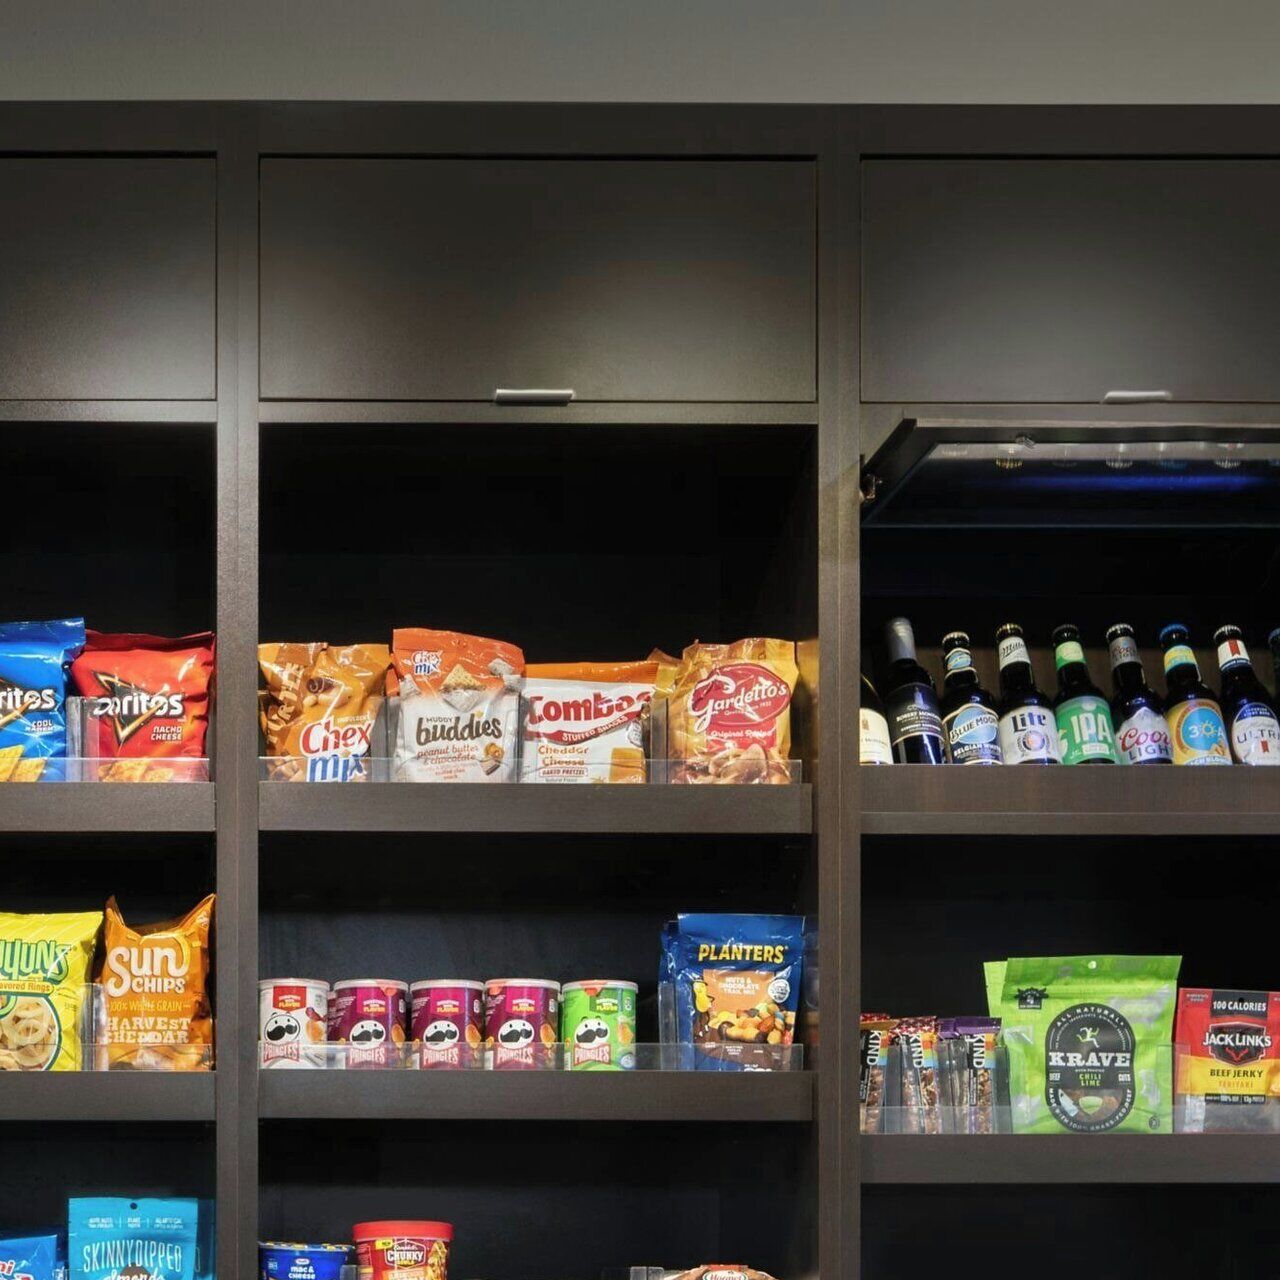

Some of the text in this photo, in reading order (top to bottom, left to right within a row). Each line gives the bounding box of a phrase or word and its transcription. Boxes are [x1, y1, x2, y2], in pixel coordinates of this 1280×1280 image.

[689, 674, 789, 732] Gardetto's
[416, 713, 503, 746] buddies
[1011, 711, 1048, 734] Lite
[1071, 714, 1112, 743] IPA
[300, 716, 372, 755] Chex
[538, 745, 589, 756] Cheddar
[307, 753, 367, 782] mix
[698, 944, 784, 964] PLANTERS
[107, 946, 190, 998] Sun
[26, 981, 51, 993] Rings
[131, 977, 185, 994] CHIPS
[155, 1000, 184, 1012] GRAIN
[1213, 1001, 1267, 1013] 100 CALORIES
[108, 1017, 191, 1031] HARVEST
[105, 1030, 190, 1044] CHEDDAR
[1202, 1032, 1235, 1046] JACK
[264, 1042, 300, 1064] PRINGLES
[349, 1048, 386, 1065] PRINGLES
[423, 1048, 458, 1065] PRINGLES
[866, 1029, 882, 1066] KIND
[909, 1033, 925, 1069] KIND
[972, 1033, 987, 1069] KIND
[1048, 1052, 1131, 1067] KRAVE
[1210, 1068, 1263, 1078] BEEF JERKY
[83, 1239, 183, 1273] SKINNYDIPPED
[387, 1250, 424, 1262] CHUNKY
